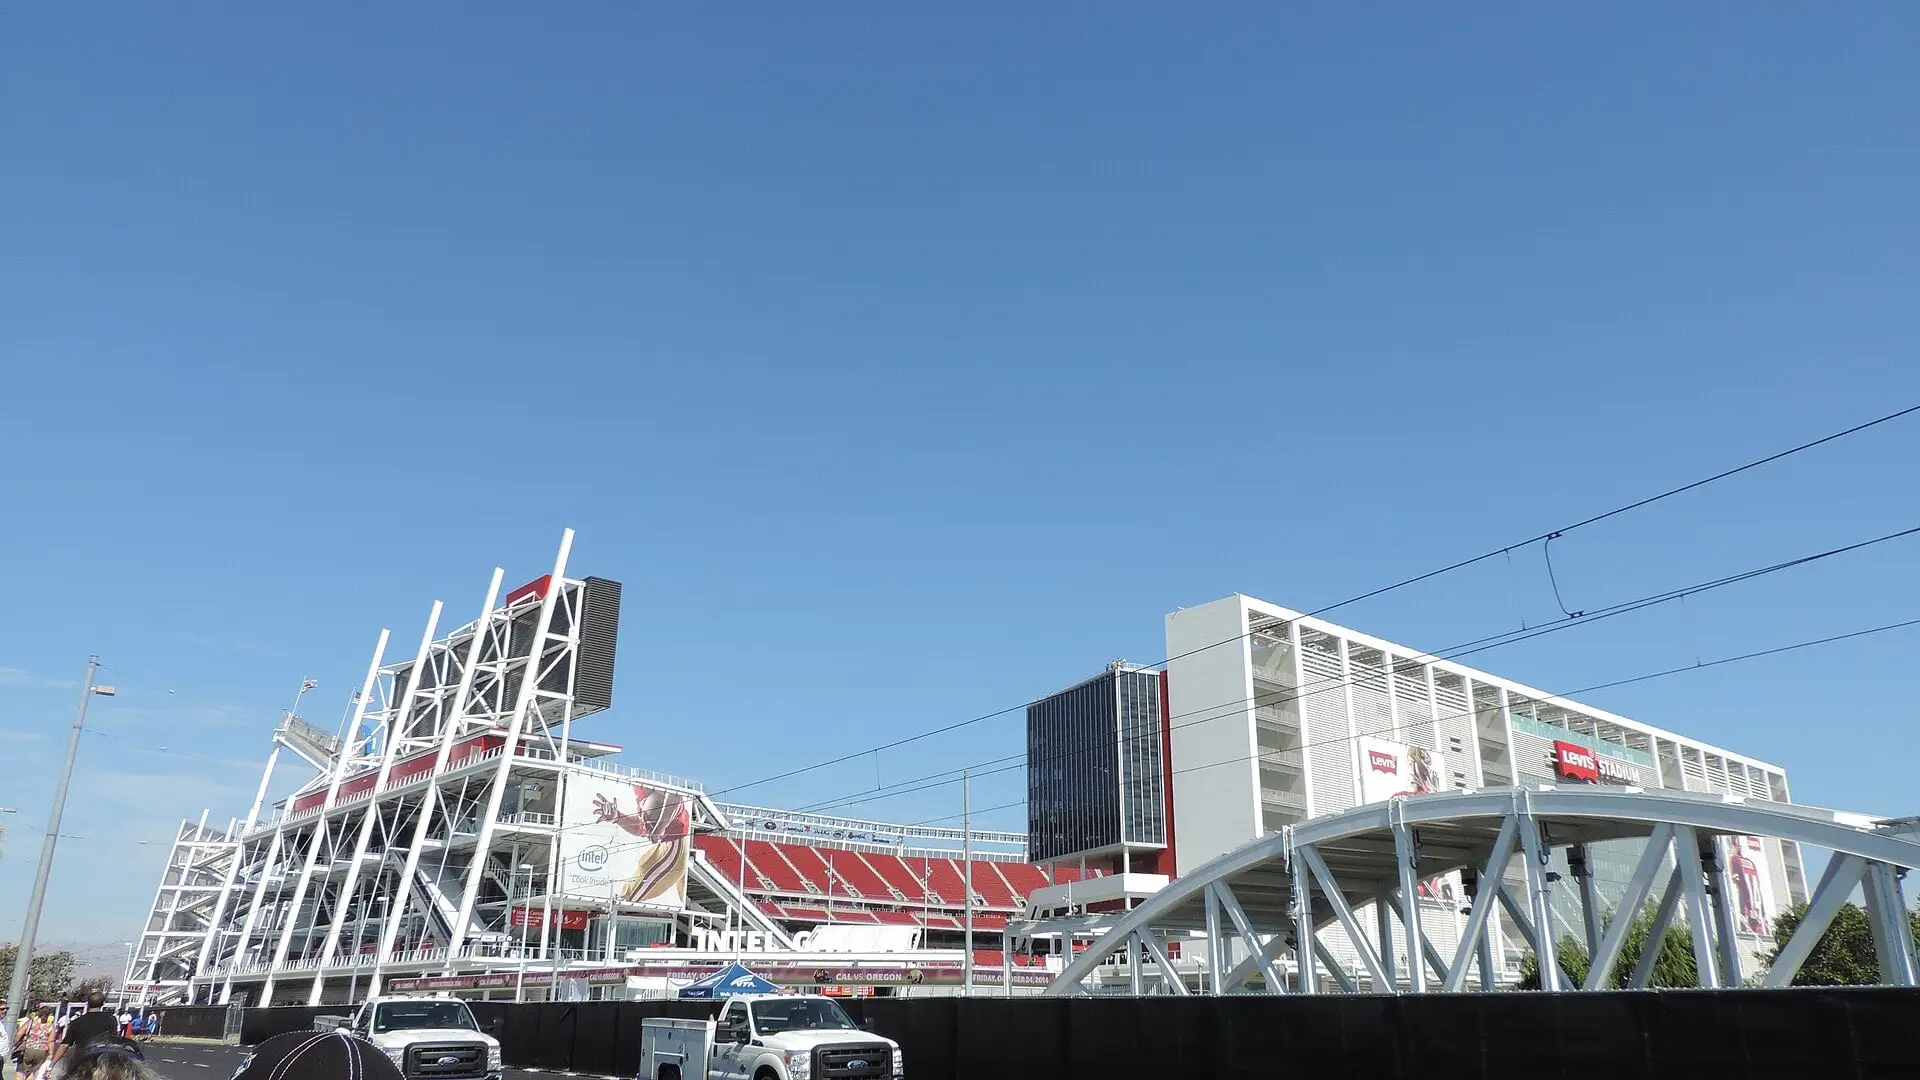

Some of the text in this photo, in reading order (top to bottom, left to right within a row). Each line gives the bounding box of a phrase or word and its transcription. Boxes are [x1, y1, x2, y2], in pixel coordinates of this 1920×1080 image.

[1562, 750, 1640, 783] Levi's STADIUM
[581, 849, 604, 864] intel
[697, 930, 778, 953] INTEL
[667, 972, 698, 981] FRIDAY,
[836, 973, 853, 981] CAL
[866, 973, 902, 981] OREGON
[973, 974, 997, 983] FRIDAY,
[1035, 976, 1049, 984] 2014
